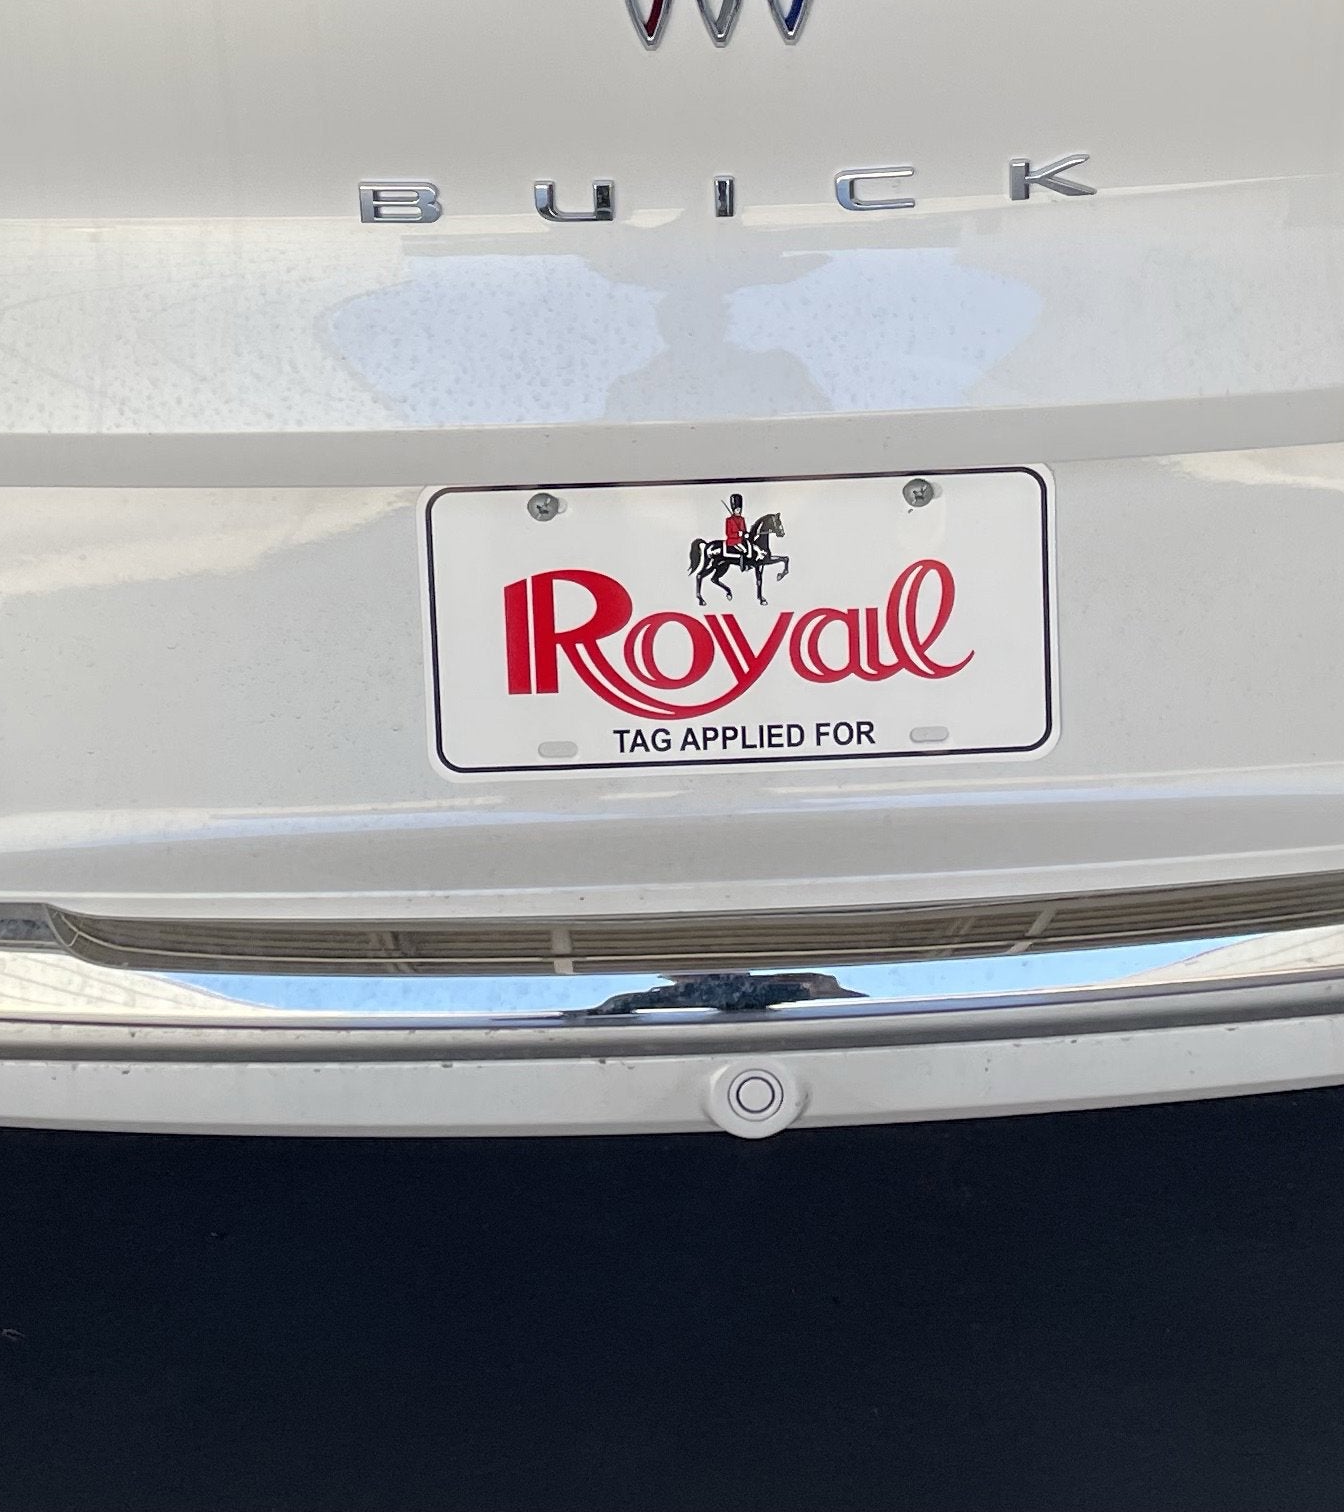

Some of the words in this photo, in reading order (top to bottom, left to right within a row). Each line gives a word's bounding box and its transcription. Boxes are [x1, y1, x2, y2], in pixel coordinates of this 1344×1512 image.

[358, 153, 1098, 225] BUICK
[503, 559, 975, 721] Royal
[613, 727, 672, 753] TAG
[679, 723, 805, 751] APPLIED
[815, 720, 876, 746] FOR
